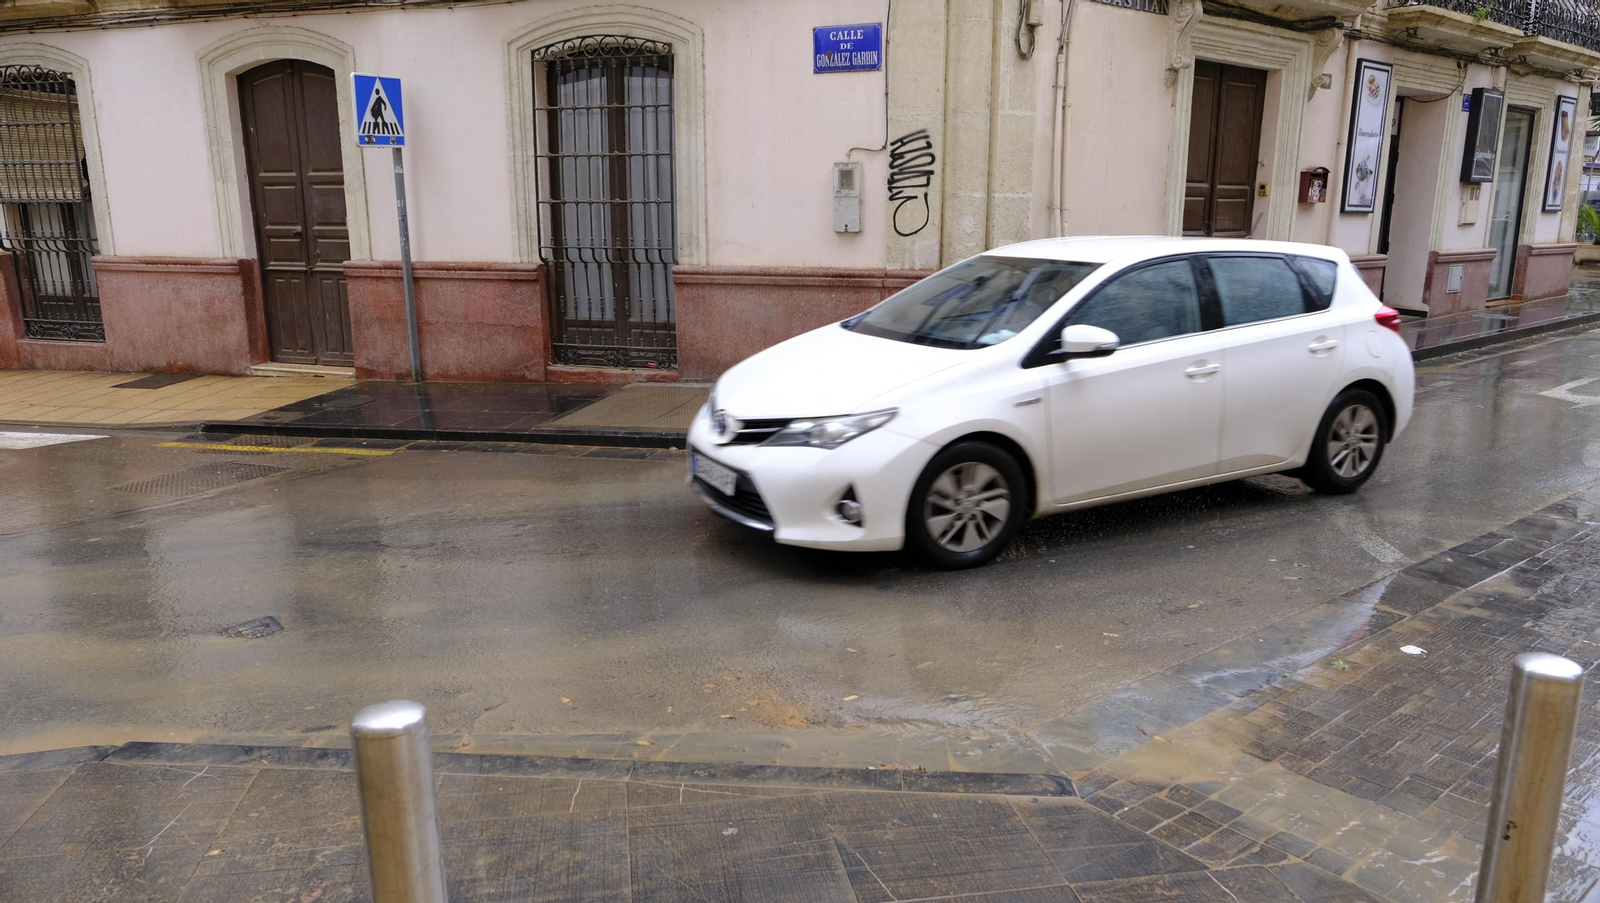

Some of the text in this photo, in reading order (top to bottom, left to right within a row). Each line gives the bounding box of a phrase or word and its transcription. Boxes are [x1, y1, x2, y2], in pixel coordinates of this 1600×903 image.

[829, 29, 864, 41] CALLE
[839, 42, 854, 50] DE
[852, 51, 878, 66] GARBIN
